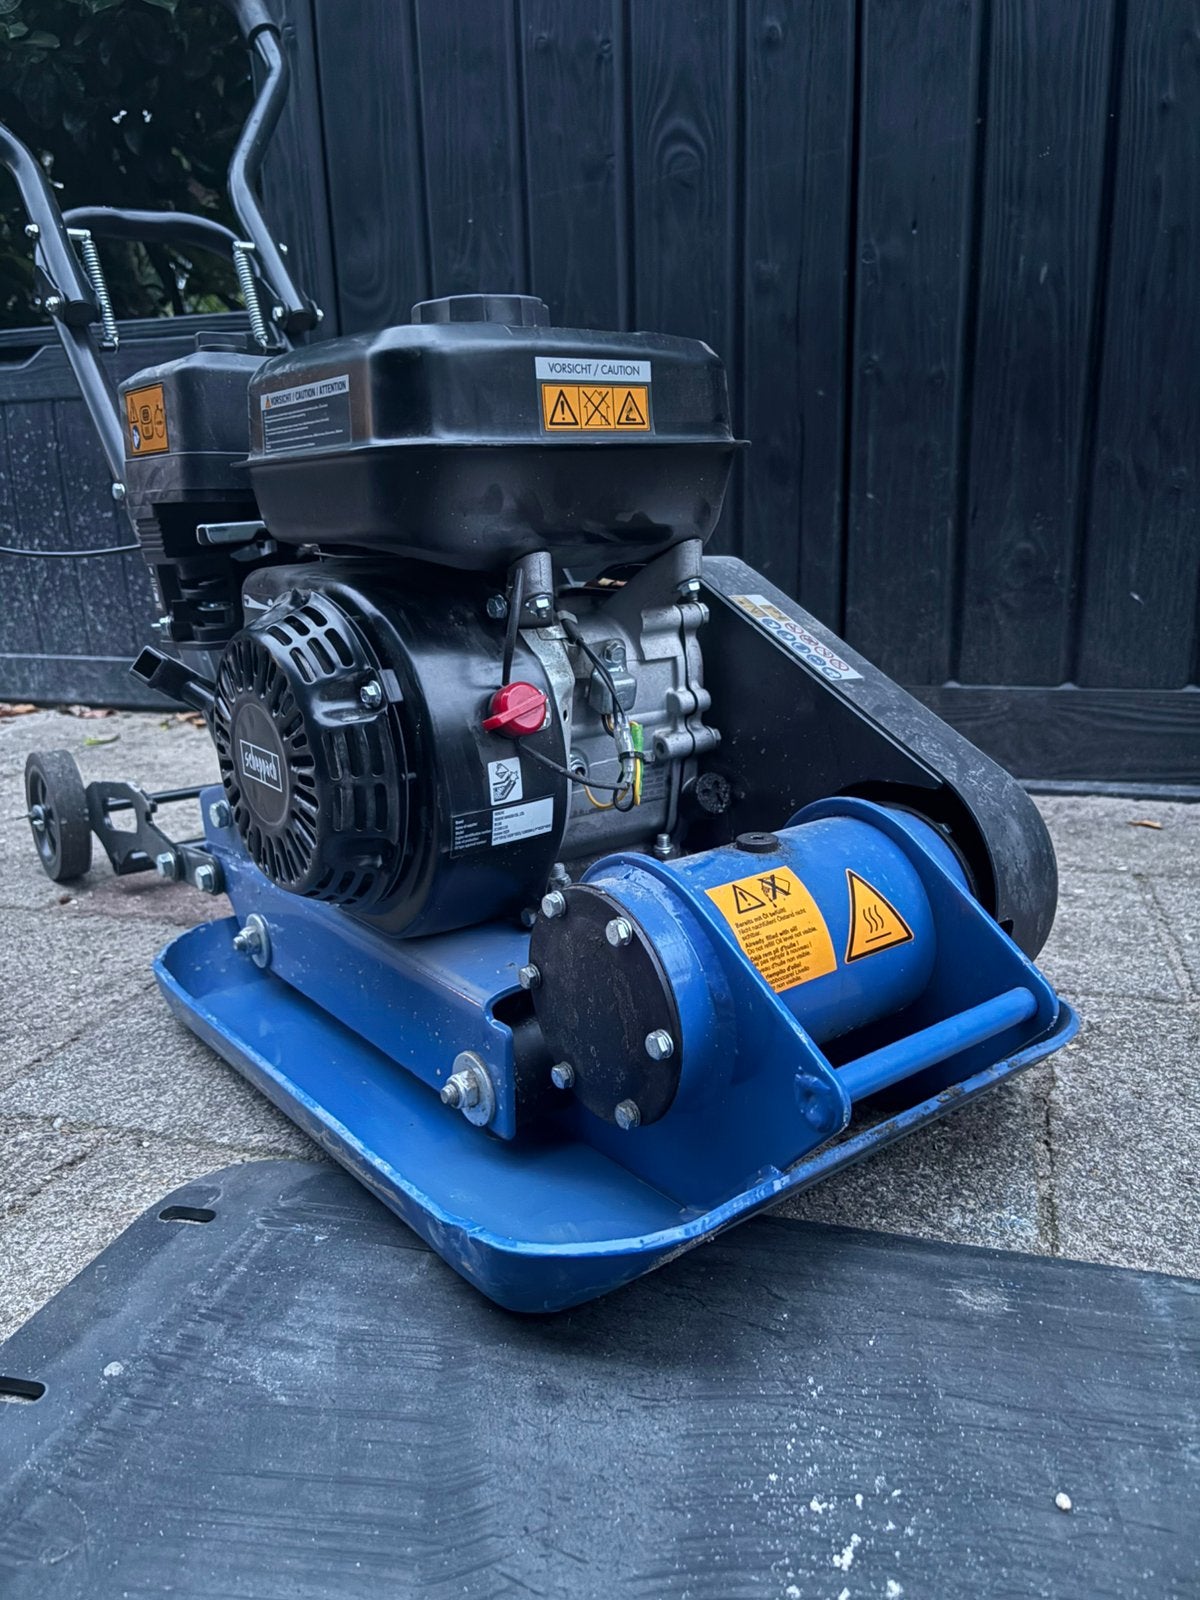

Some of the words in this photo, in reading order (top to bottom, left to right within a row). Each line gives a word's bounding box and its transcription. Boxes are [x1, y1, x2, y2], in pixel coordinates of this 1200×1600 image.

[548, 363, 592, 374] VORSICHT
[593, 363, 599, 376] /
[601, 364, 640, 376] CAUTION
[295, 387, 316, 400] CAUTION
[319, 381, 346, 395] ATTENTION
[794, 908, 806, 916] nicht
[735, 919, 754, 928] Bereits
[745, 939, 765, 948] Already
[765, 932, 779, 941] filled
[760, 958, 769, 966] pas
[790, 945, 810, 953] nouveau
